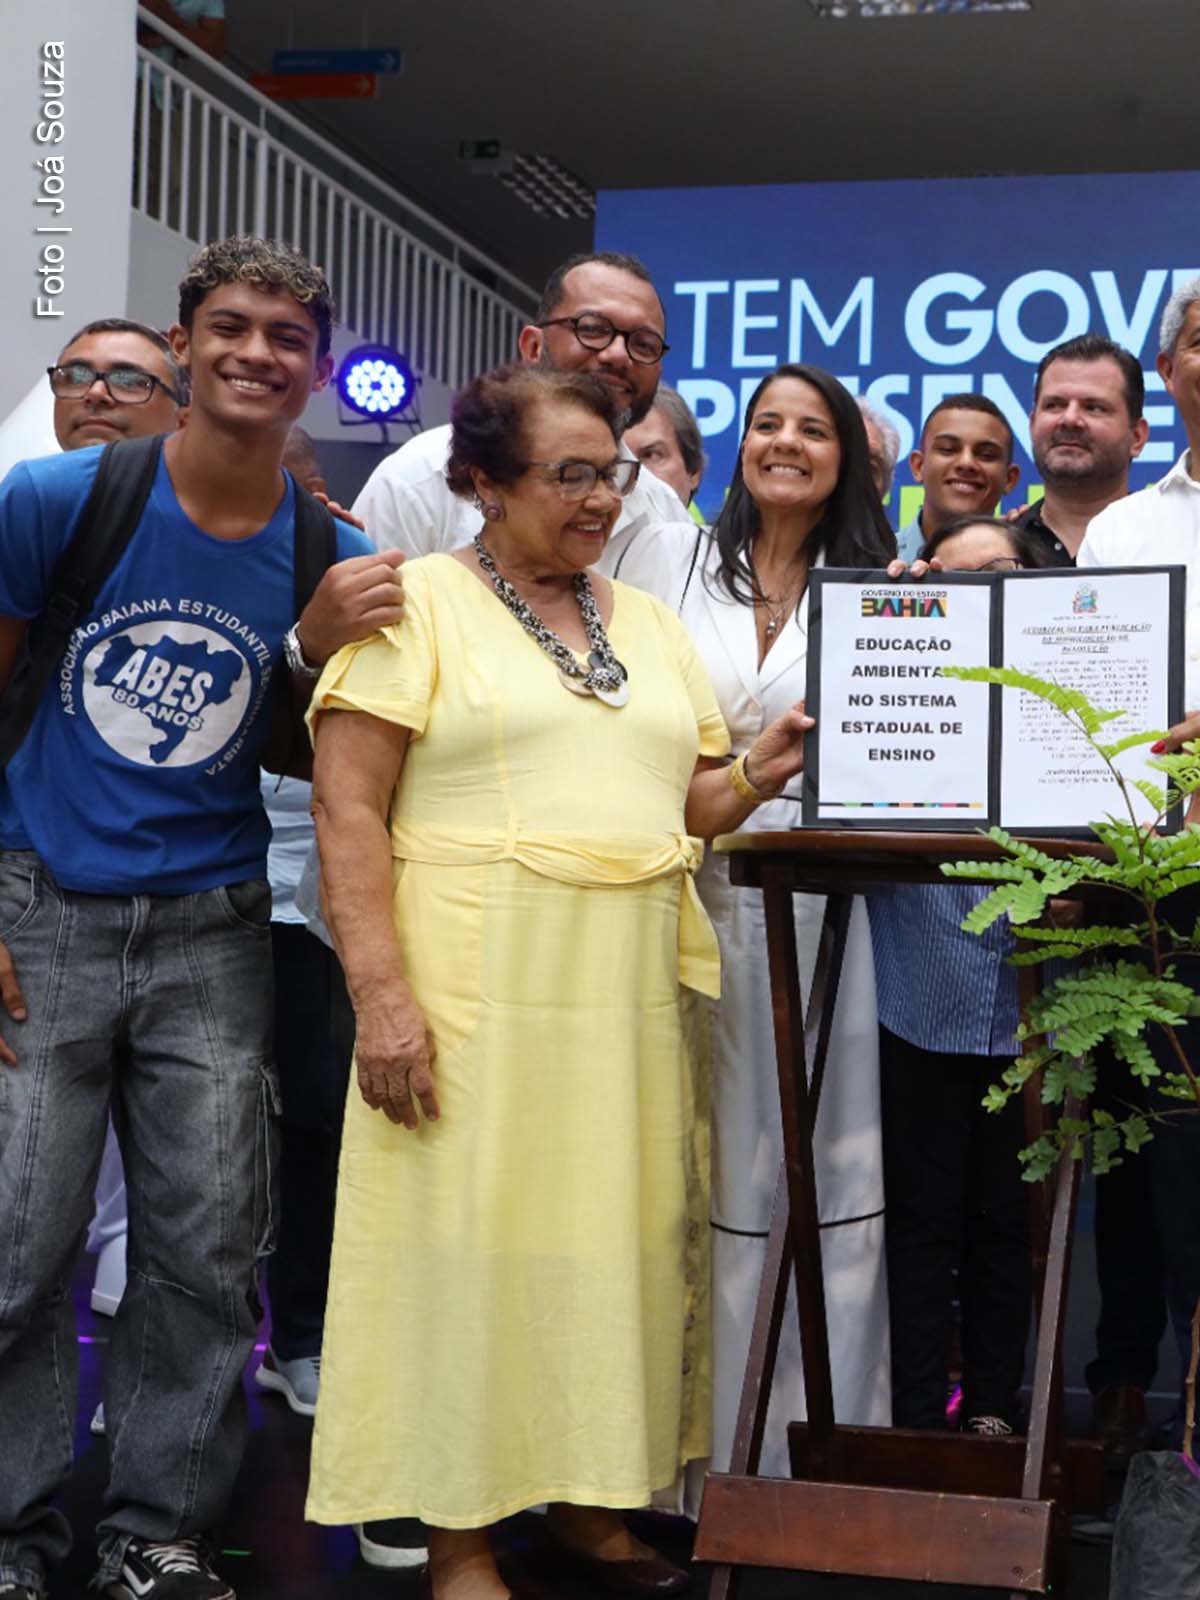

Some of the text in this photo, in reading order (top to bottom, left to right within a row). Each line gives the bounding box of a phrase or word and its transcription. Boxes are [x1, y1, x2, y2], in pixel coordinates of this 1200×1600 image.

[674, 276, 874, 369] TEM
[861, 589, 901, 597] GOVERNO
[917, 590, 948, 598] ESTADO
[861, 598, 947, 617] BAHIA
[855, 636, 952, 653] EDUCAÇÃO
[59, 619, 100, 716] ASSOCIAÇÃO
[102, 598, 172, 629] BAIANA
[178, 598, 272, 668] ESTUDANTIL
[852, 665, 948, 678] AMBIENTA
[112, 649, 214, 714] ABES
[848, 694, 957, 707] NO SISTEMA
[112, 688, 204, 731] 80 ANOS
[841, 721, 963, 734] ESTADUAL DE
[867, 748, 936, 761] ENSINO
